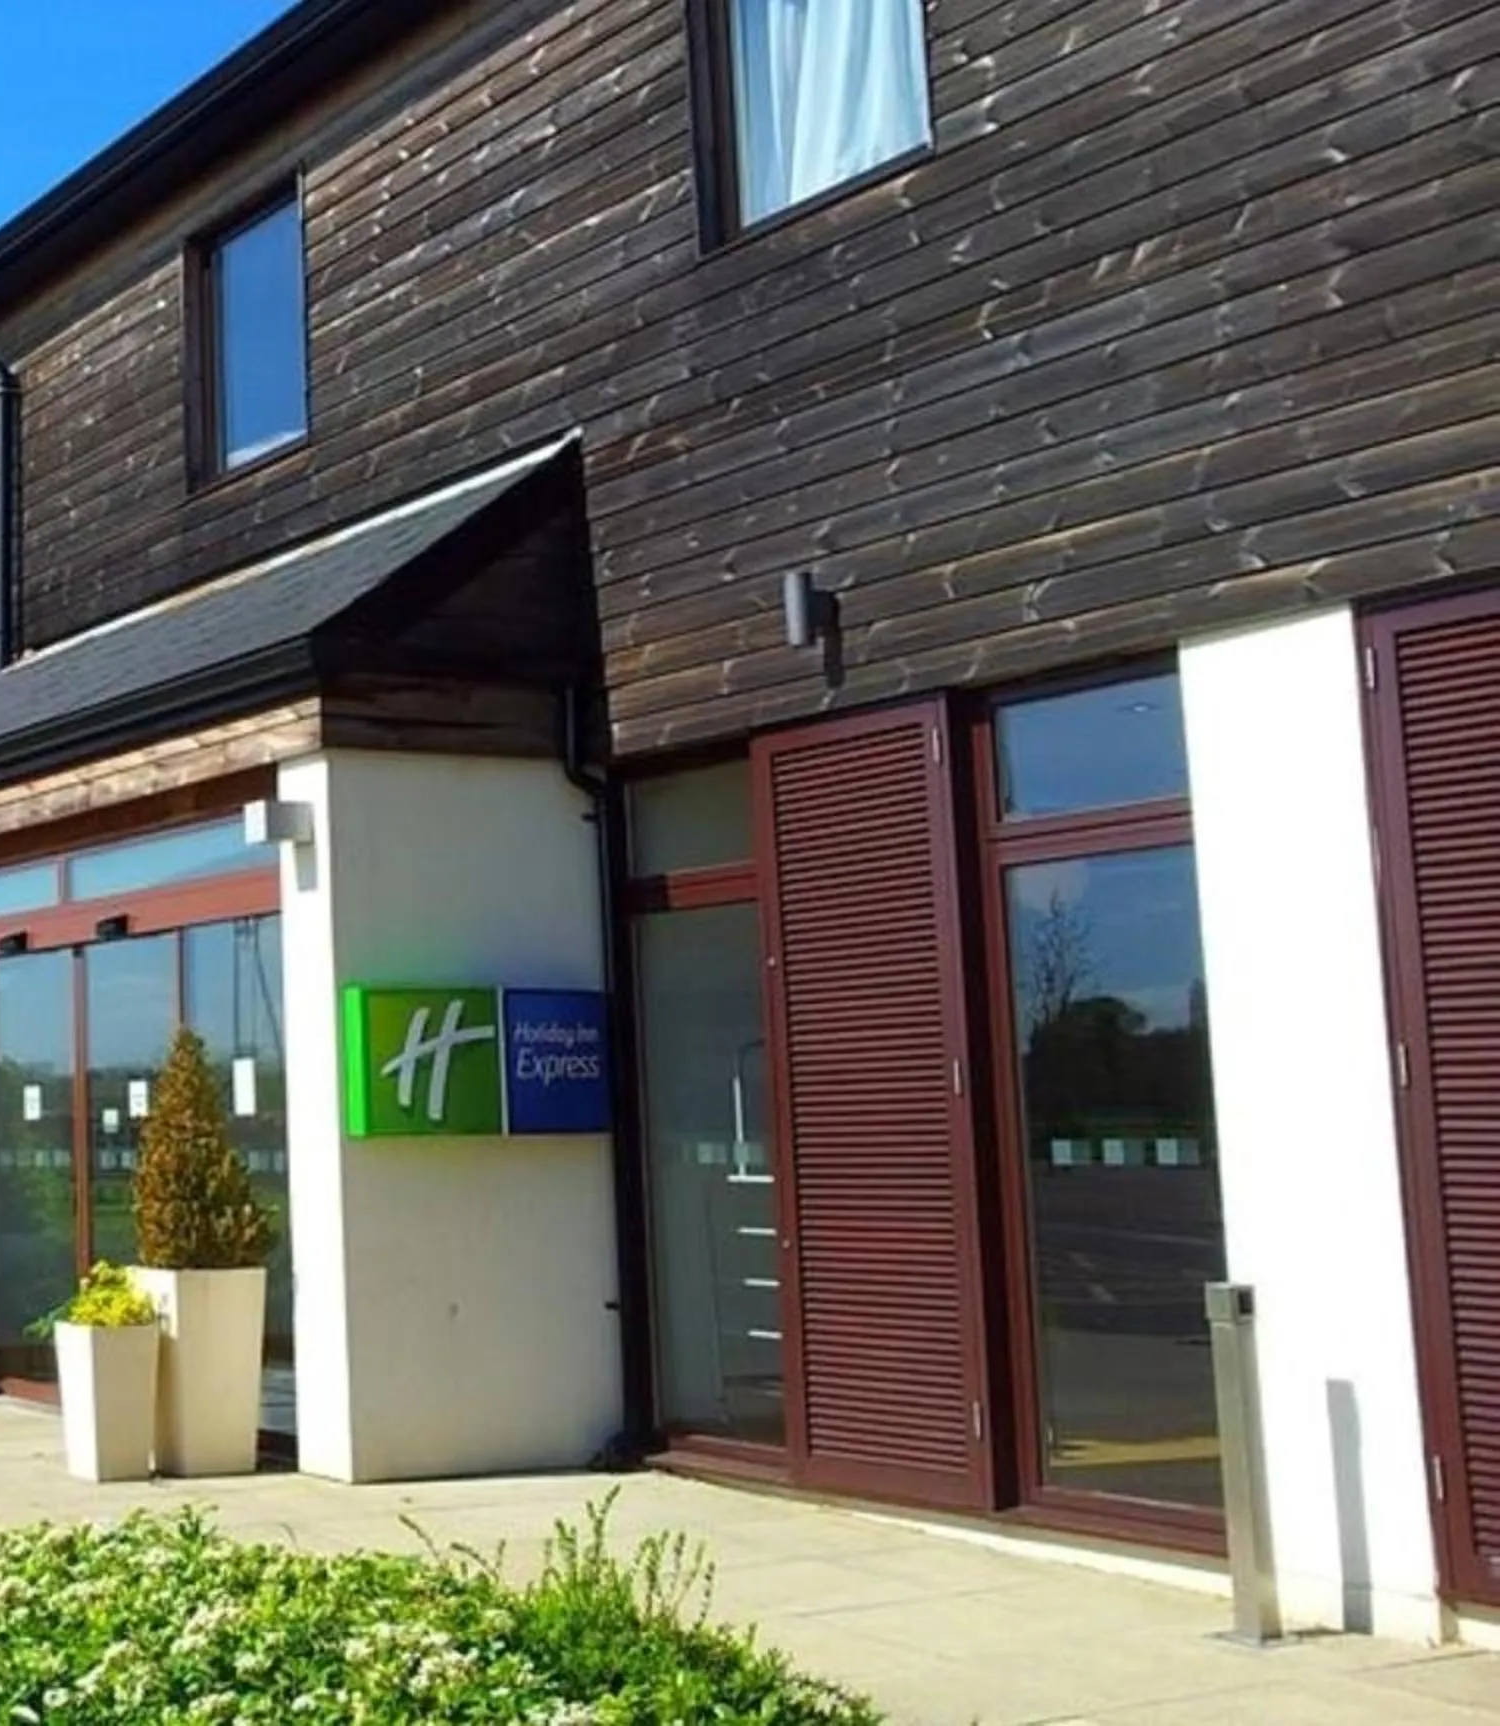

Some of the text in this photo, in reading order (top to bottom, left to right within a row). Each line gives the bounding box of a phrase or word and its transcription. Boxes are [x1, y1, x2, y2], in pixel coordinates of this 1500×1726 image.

[514, 1021, 599, 1048] Holiday Inn
[381, 999, 495, 1120] H
[516, 1047, 600, 1086] Express
